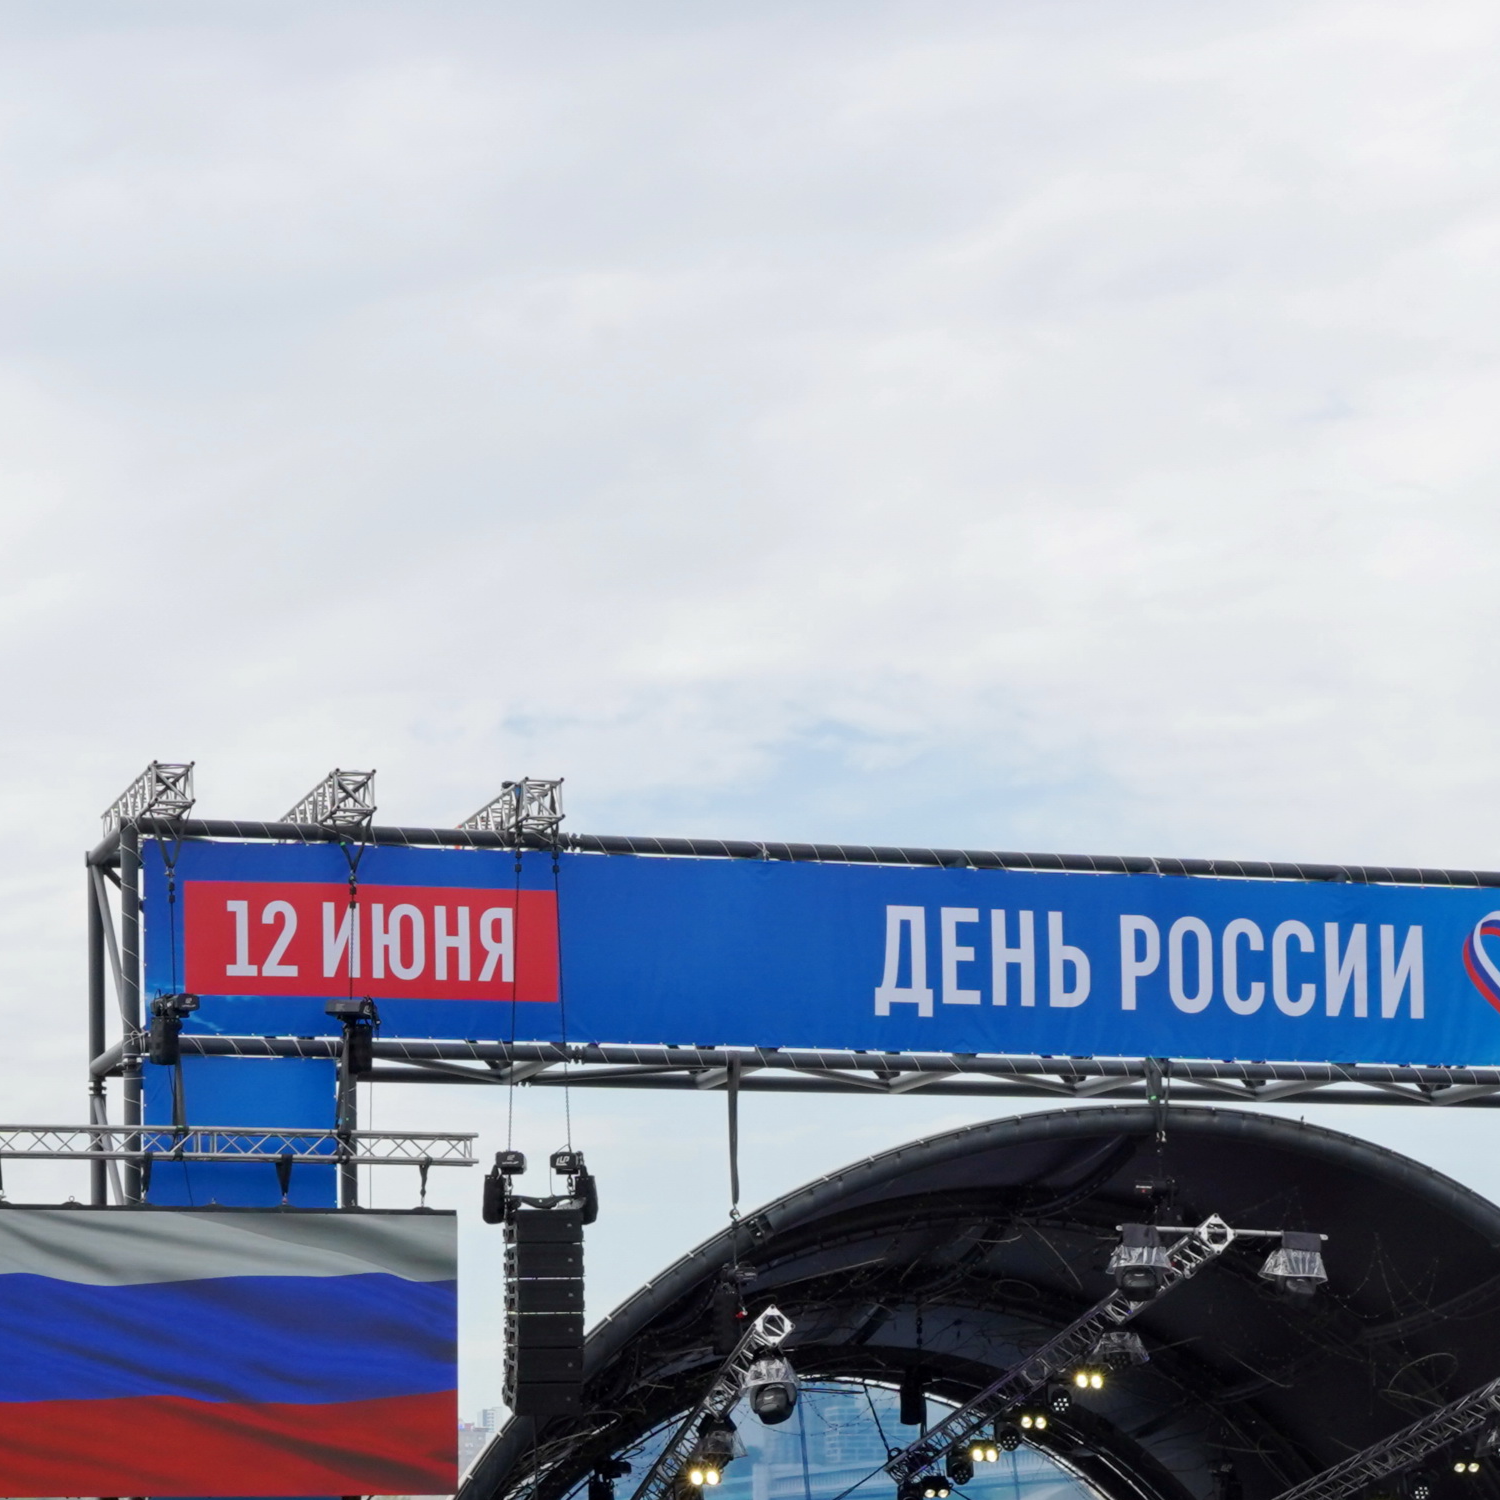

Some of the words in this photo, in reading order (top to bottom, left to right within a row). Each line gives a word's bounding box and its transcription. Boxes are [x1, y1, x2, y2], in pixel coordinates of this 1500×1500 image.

[226, 899, 299, 977] 12
[321, 901, 515, 983] ИЮНЯ
[874, 904, 1090, 1018] ДЕНЬ
[1119, 914, 1424, 1019] РОССИИ
